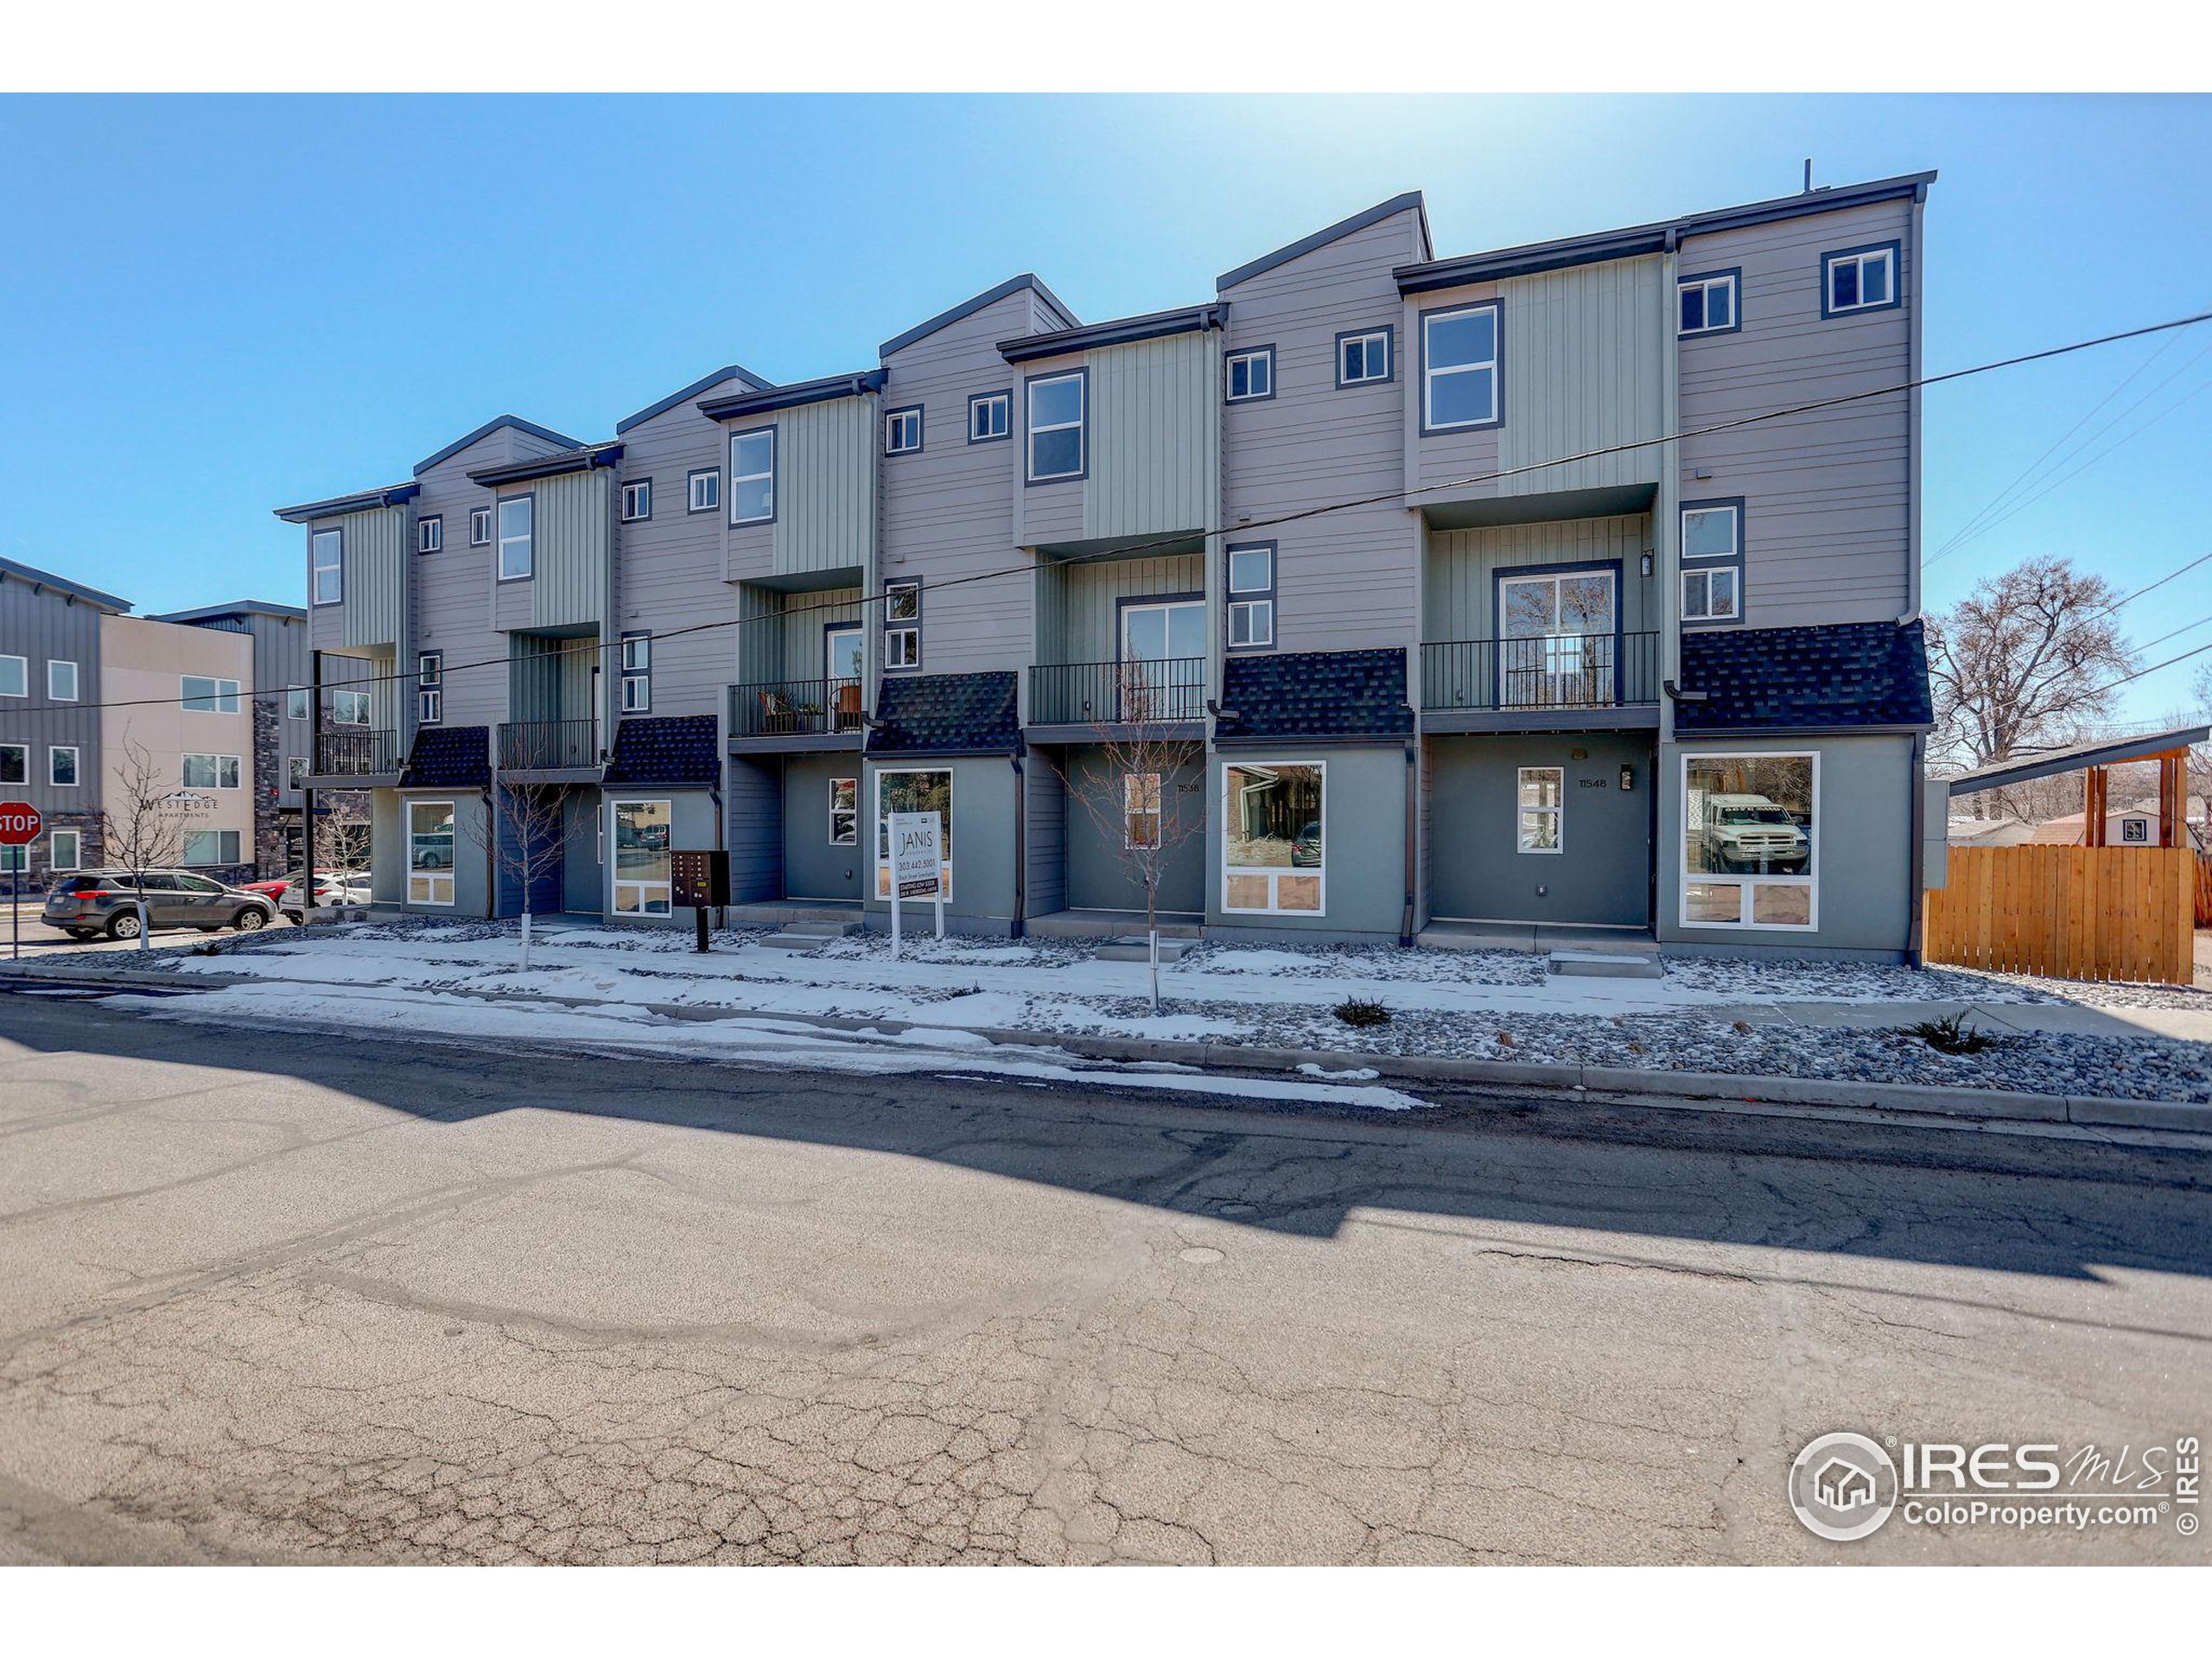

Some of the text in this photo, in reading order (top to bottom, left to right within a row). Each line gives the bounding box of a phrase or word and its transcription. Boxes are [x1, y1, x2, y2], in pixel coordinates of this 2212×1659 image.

[1579, 779, 1606, 788] 11548
[0, 816, 38, 831] TOP
[899, 830, 933, 856] JANIS
